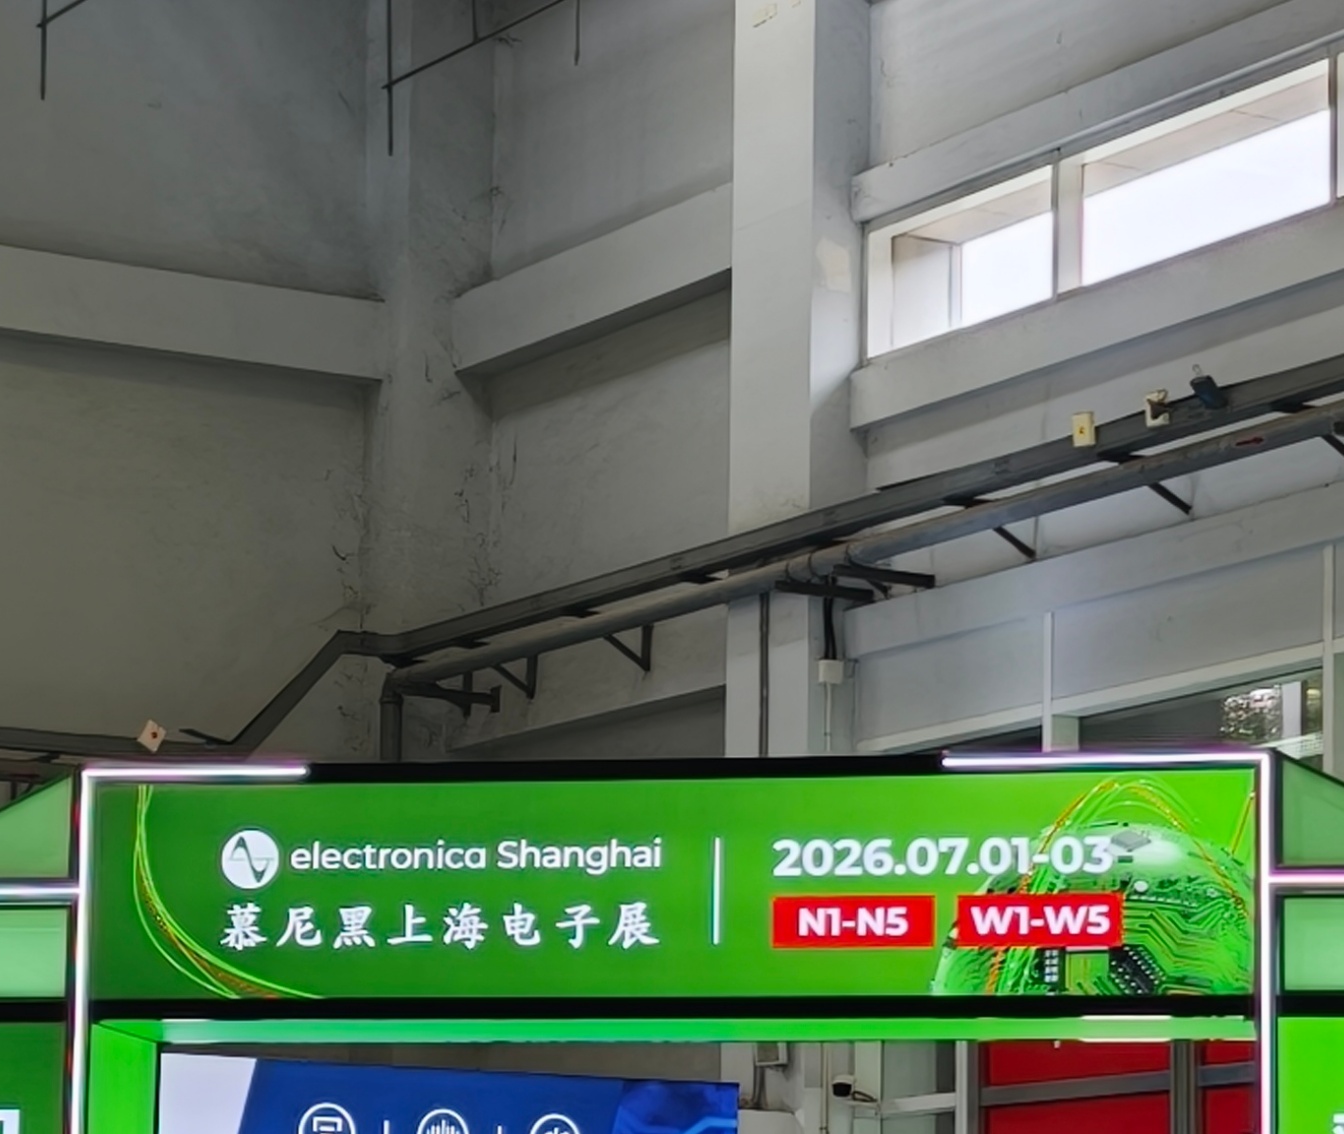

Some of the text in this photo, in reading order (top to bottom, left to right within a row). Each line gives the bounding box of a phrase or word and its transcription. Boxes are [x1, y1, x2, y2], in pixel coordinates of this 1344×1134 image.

[290, 836, 661, 875] electronica Shanghai
[772, 836, 1116, 877] 2026.07.01-03
[219, 902, 660, 951] 慕尼黑上海电子展
[797, 903, 1111, 938] N1-N5 W1-W5
